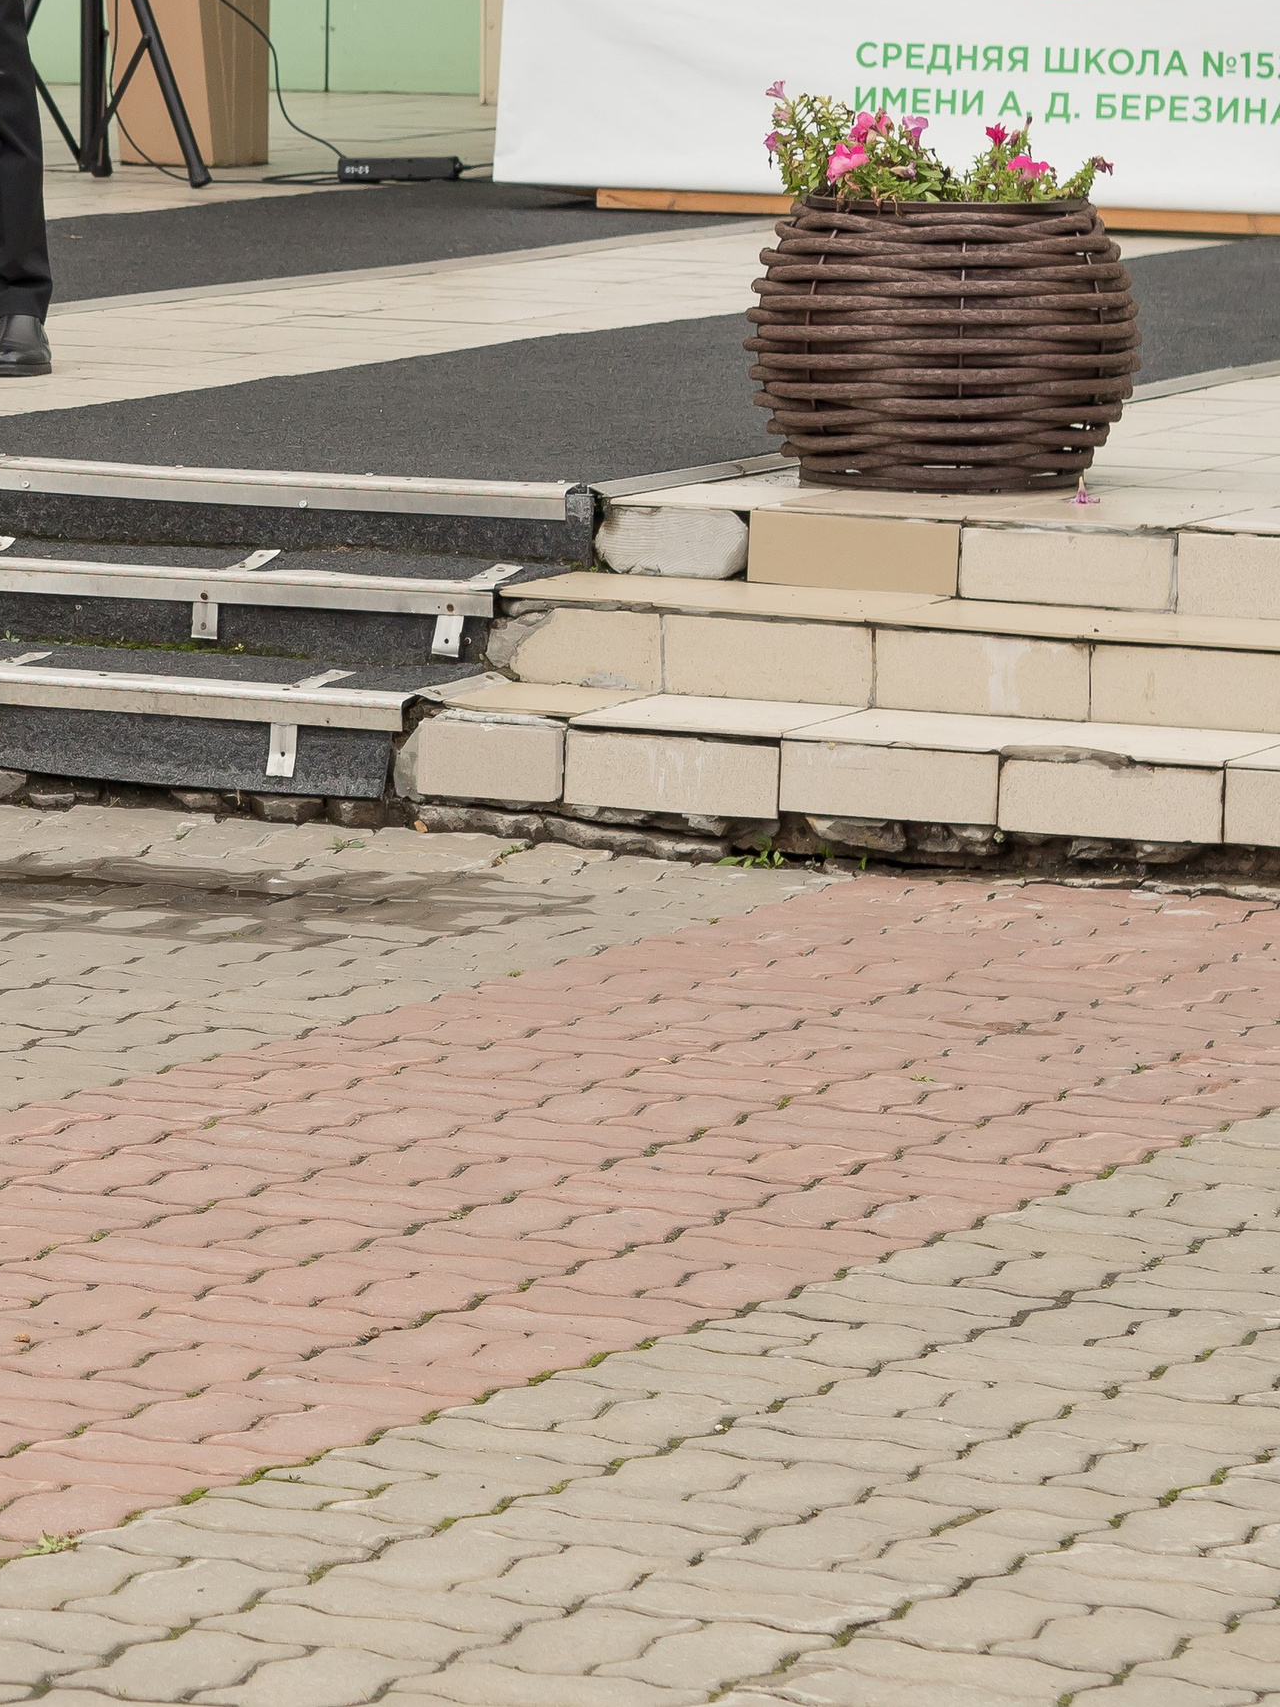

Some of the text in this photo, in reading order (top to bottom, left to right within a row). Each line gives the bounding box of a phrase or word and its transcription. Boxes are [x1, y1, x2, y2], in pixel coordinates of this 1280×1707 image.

[855, 41, 1280, 80] СРЕДНЯЯ ШКОЛА №15
[854, 86, 986, 117] ИМЕНИ
[997, 90, 1033, 118] А.
[1044, 92, 1081, 124] Д.
